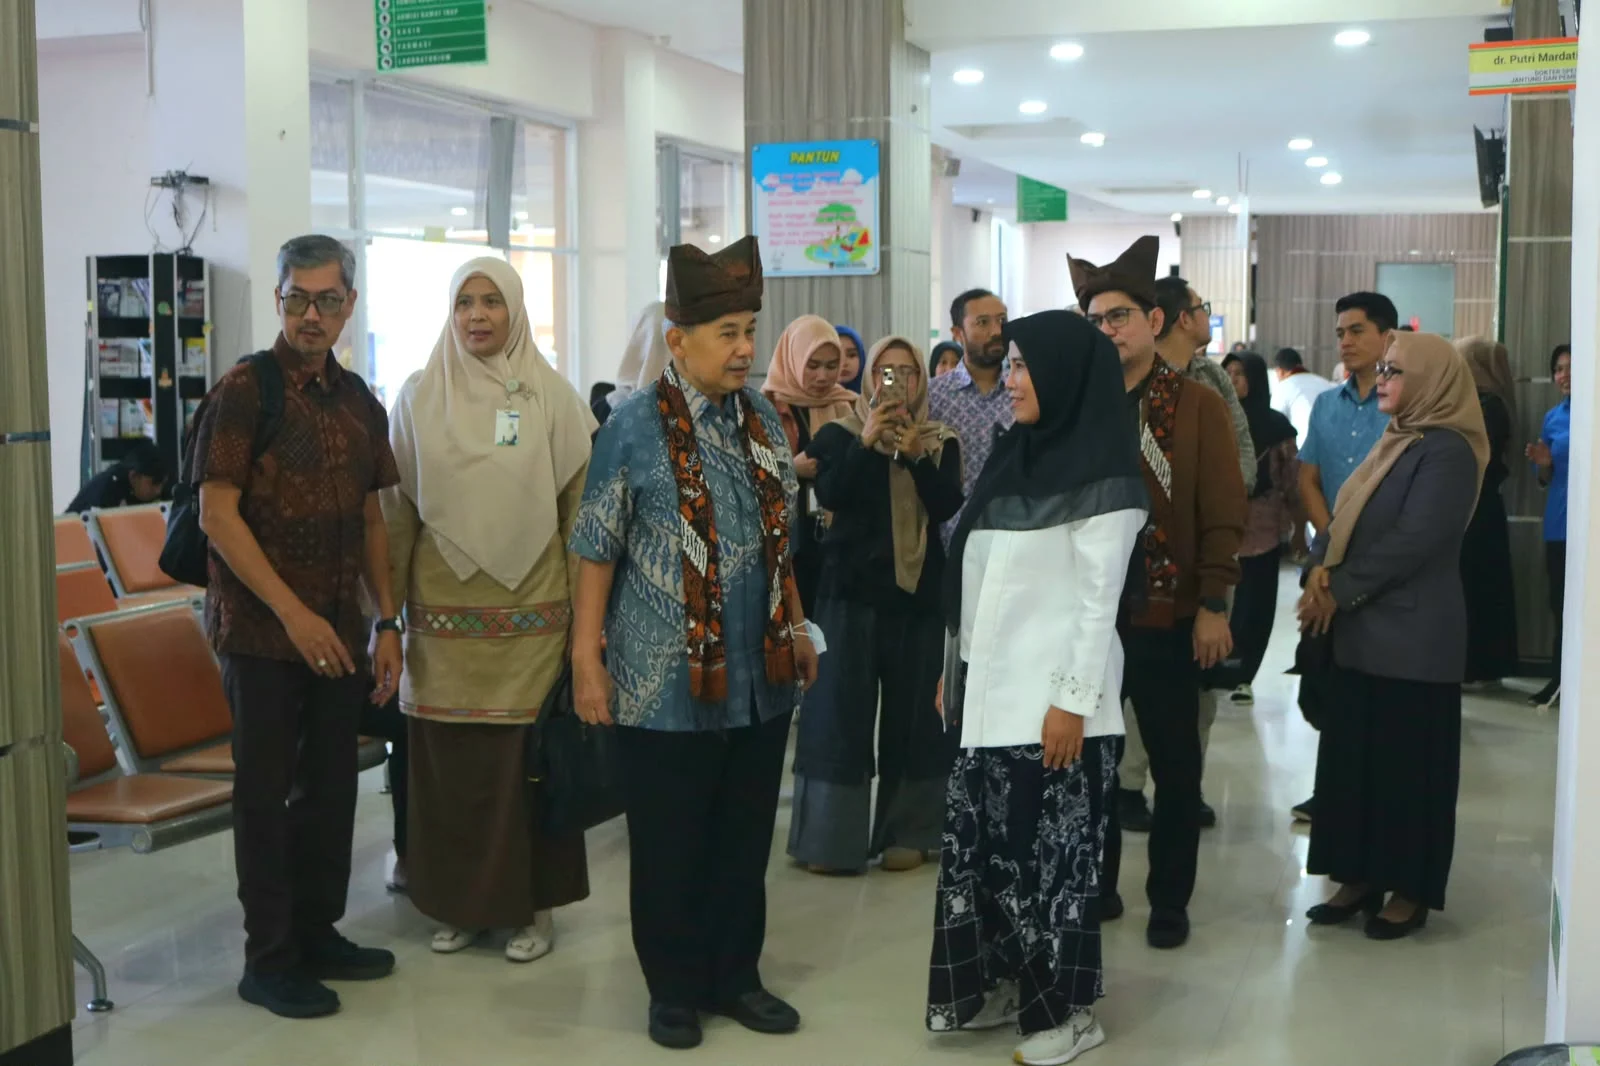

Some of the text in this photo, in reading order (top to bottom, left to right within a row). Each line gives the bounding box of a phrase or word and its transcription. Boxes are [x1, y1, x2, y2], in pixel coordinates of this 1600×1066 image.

[1493, 55, 1506, 65] dr.
[1510, 53, 1535, 64] Putri
[790, 150, 840, 164] PANTUN
